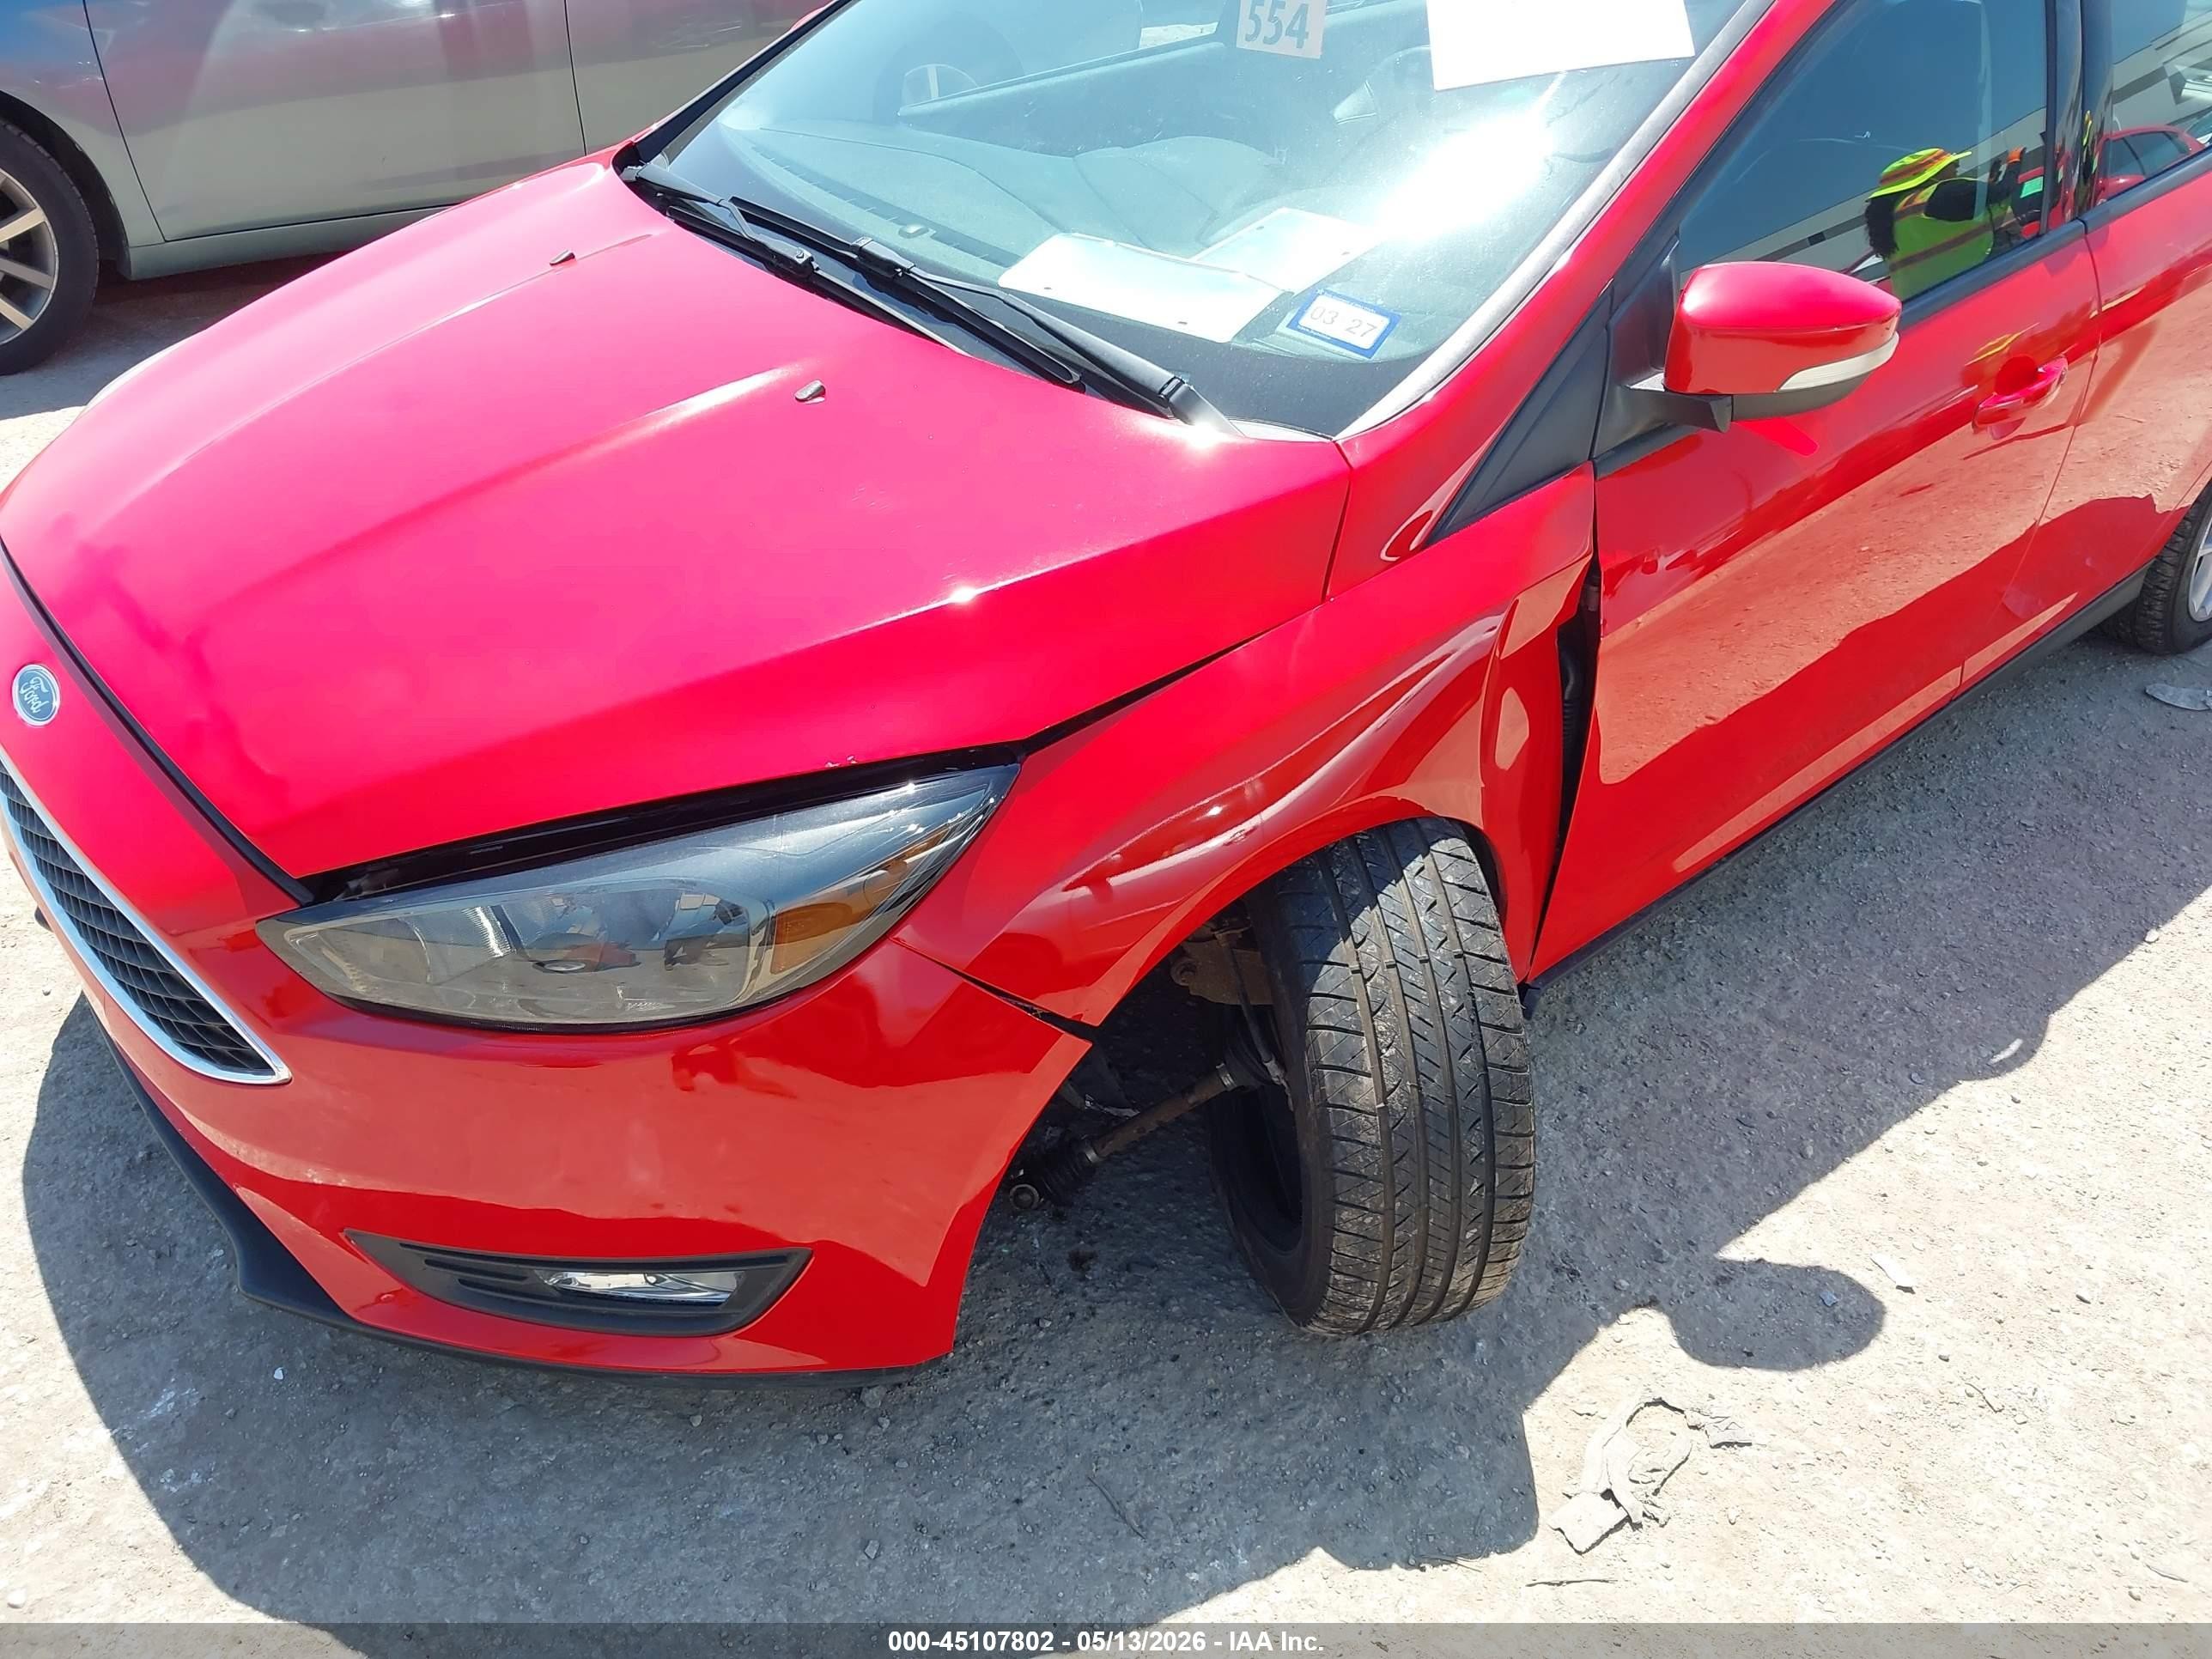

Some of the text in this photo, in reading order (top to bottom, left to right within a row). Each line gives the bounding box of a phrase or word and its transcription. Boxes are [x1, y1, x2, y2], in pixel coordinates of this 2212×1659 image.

[1244, 0, 1310, 49] 554
[1310, 306, 1339, 325] 03
[1345, 319, 1377, 337] 27
[20, 676, 49, 714] Ford
